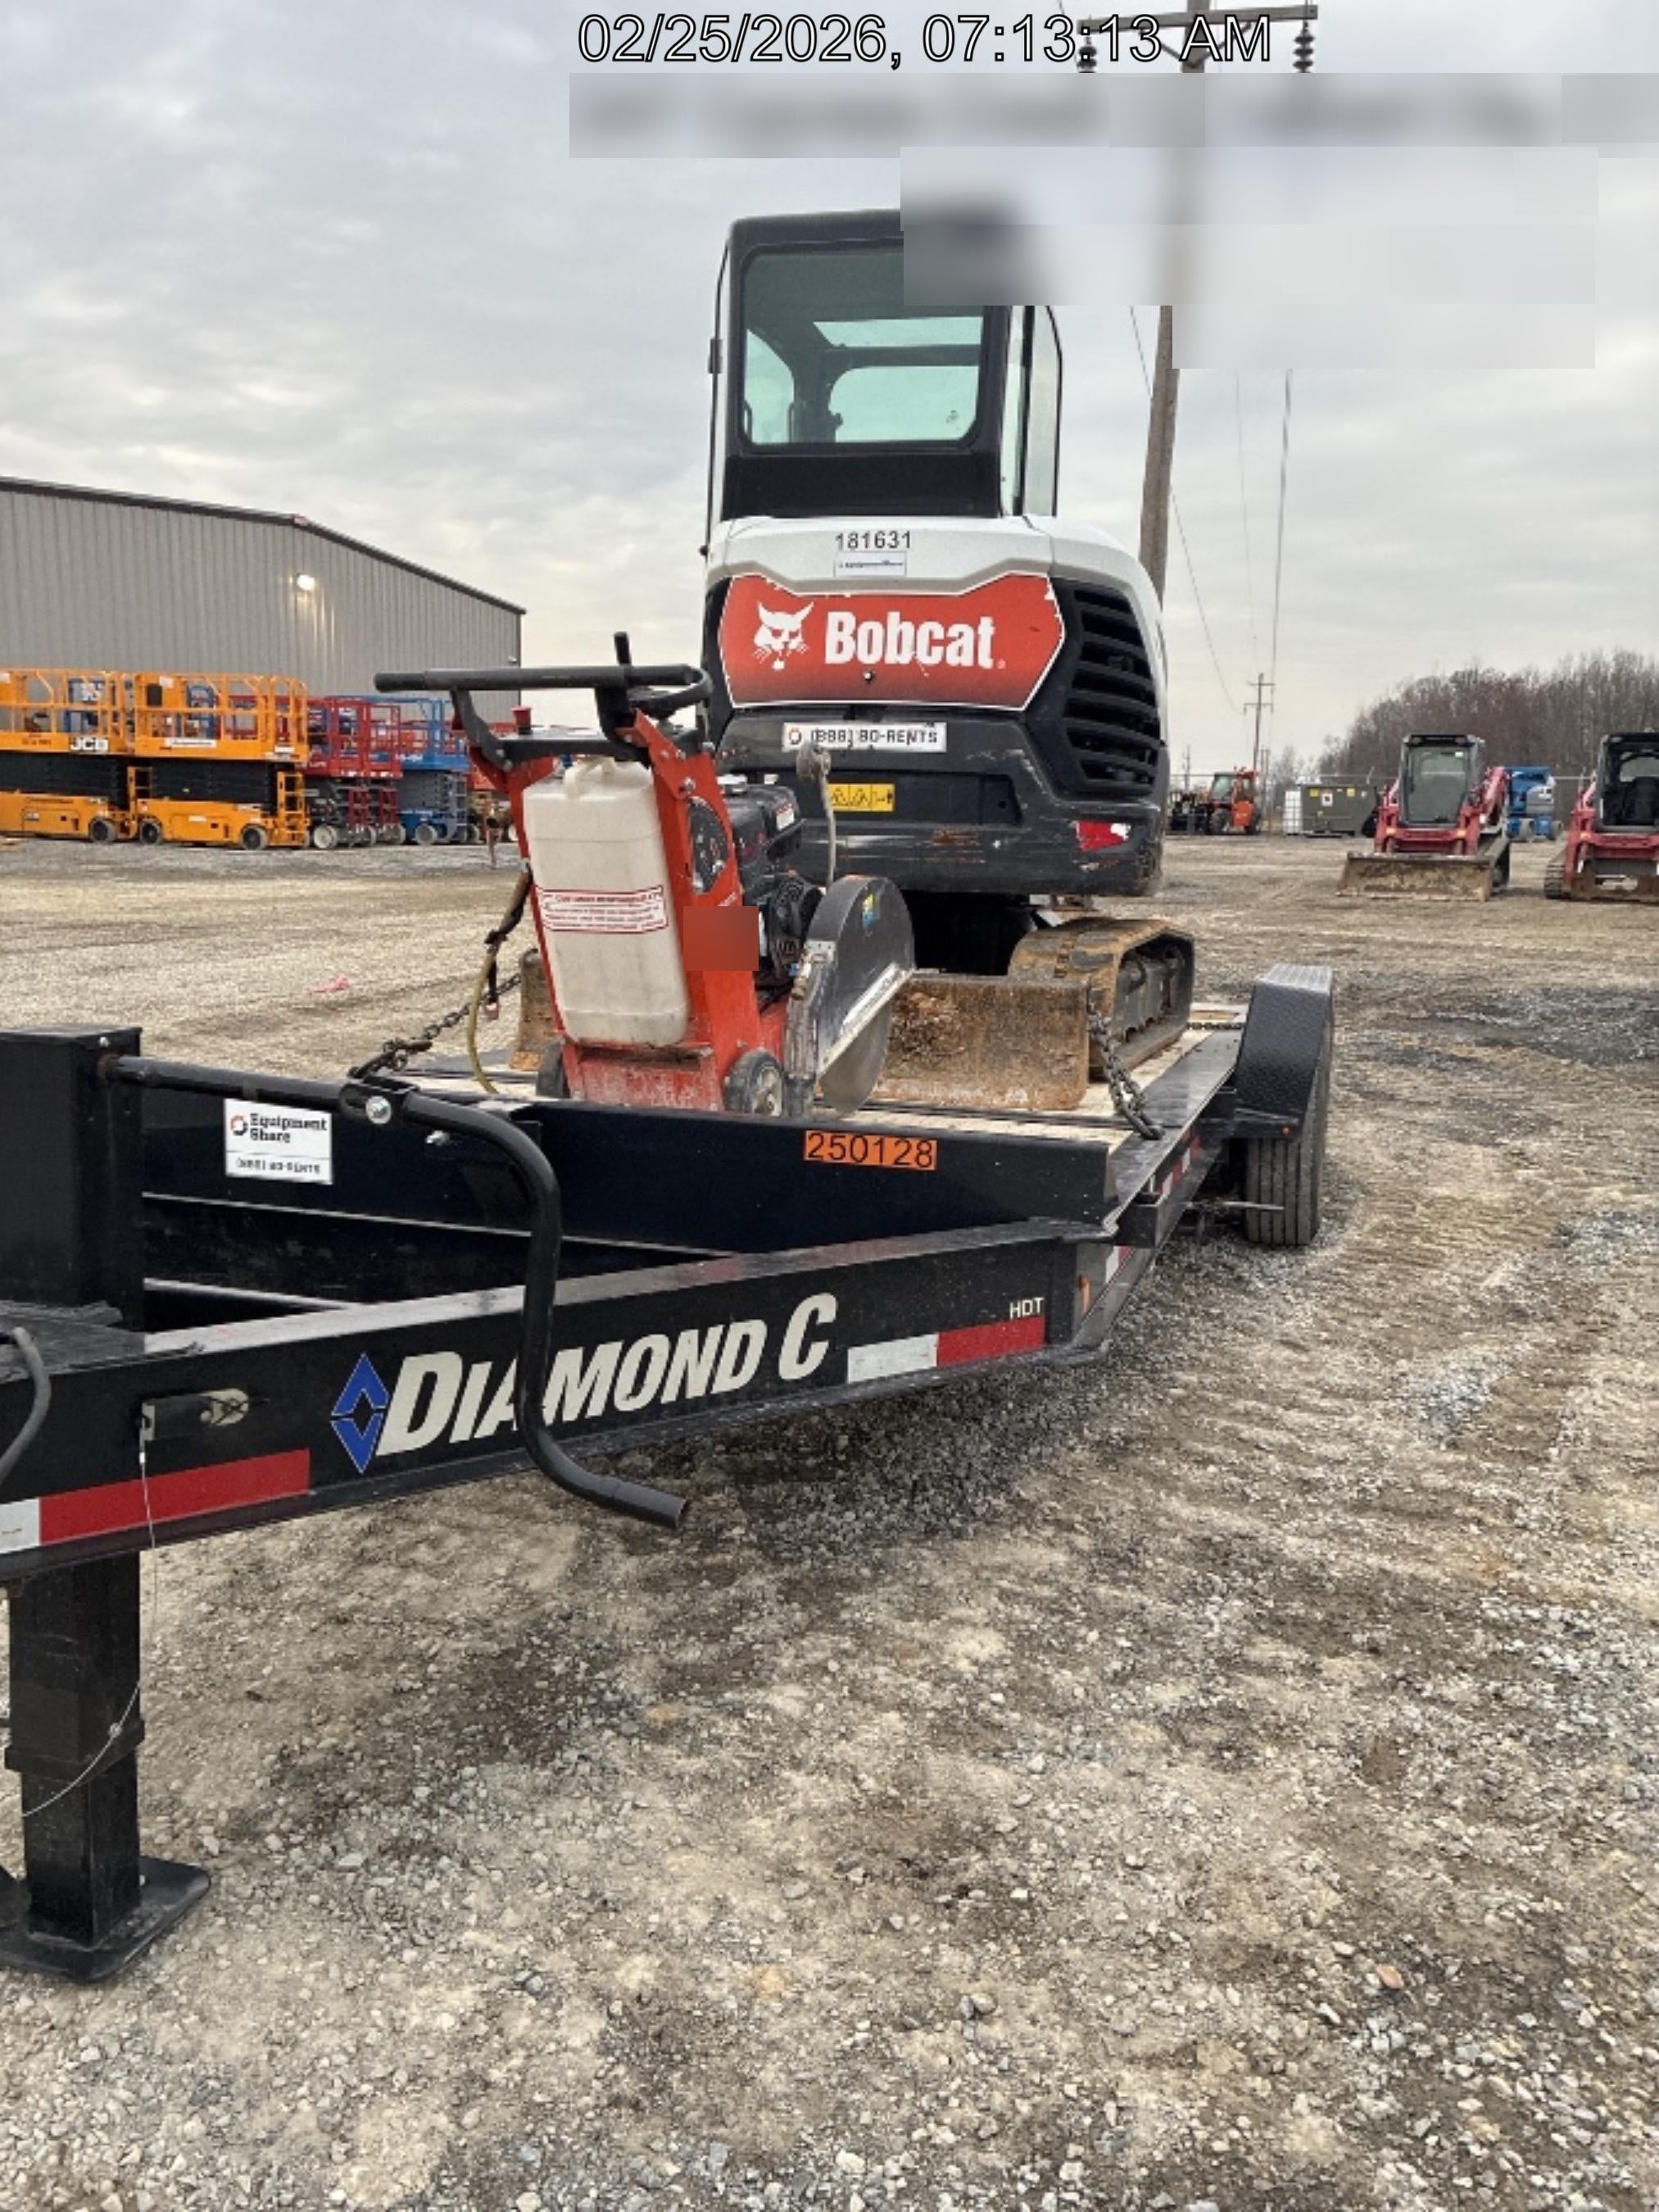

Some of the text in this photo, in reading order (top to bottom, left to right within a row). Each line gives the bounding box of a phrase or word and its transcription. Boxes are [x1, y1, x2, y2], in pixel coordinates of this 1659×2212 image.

[836, 530, 910, 550] 181631
[824, 611, 995, 669] Bobcat
[250, 1113, 327, 1131] Equipment
[250, 1128, 290, 1143] Share
[807, 1132, 932, 1168] 250128
[1009, 1297, 1045, 1319] HDT
[778, 1293, 838, 1380] C
